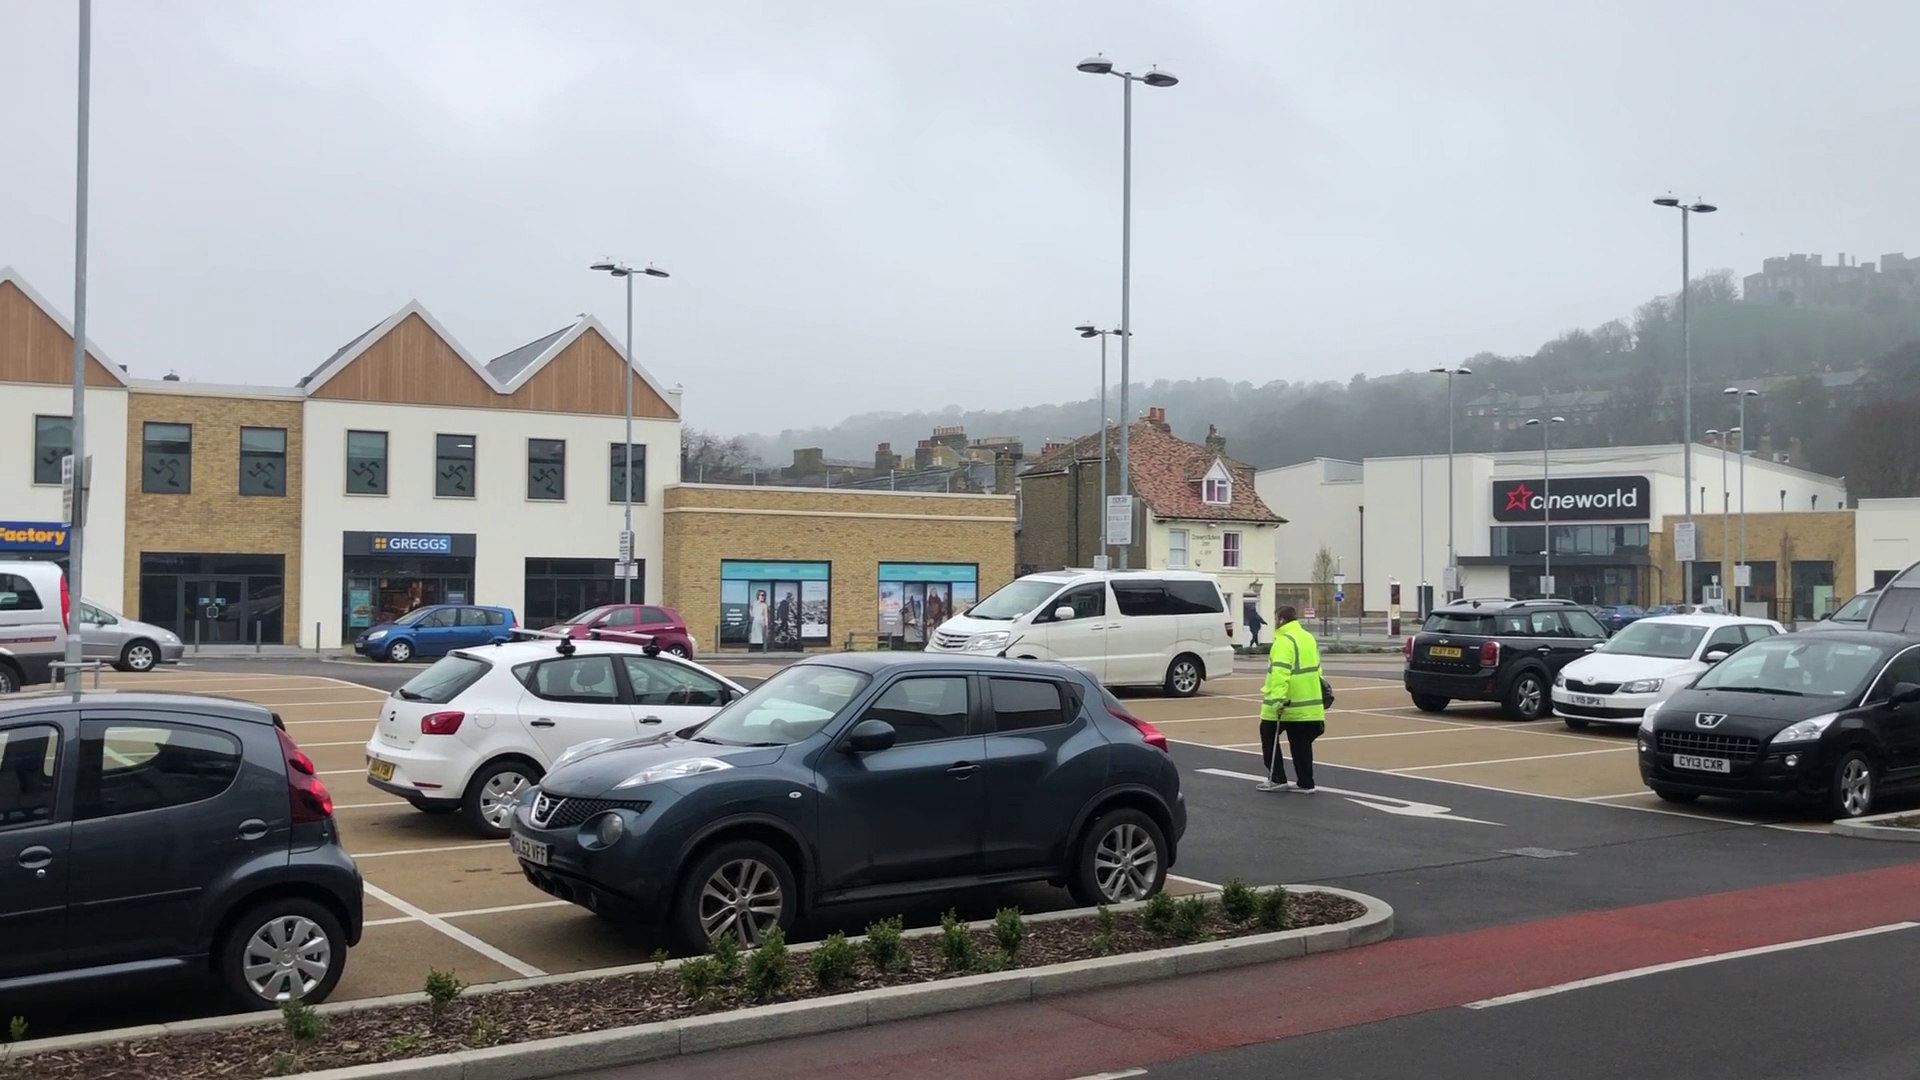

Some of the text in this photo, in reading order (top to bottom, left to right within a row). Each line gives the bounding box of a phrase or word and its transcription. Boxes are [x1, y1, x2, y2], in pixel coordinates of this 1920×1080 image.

[389, 537, 448, 550] GREGGS
[1679, 755, 1724, 771] CY13 CXR
